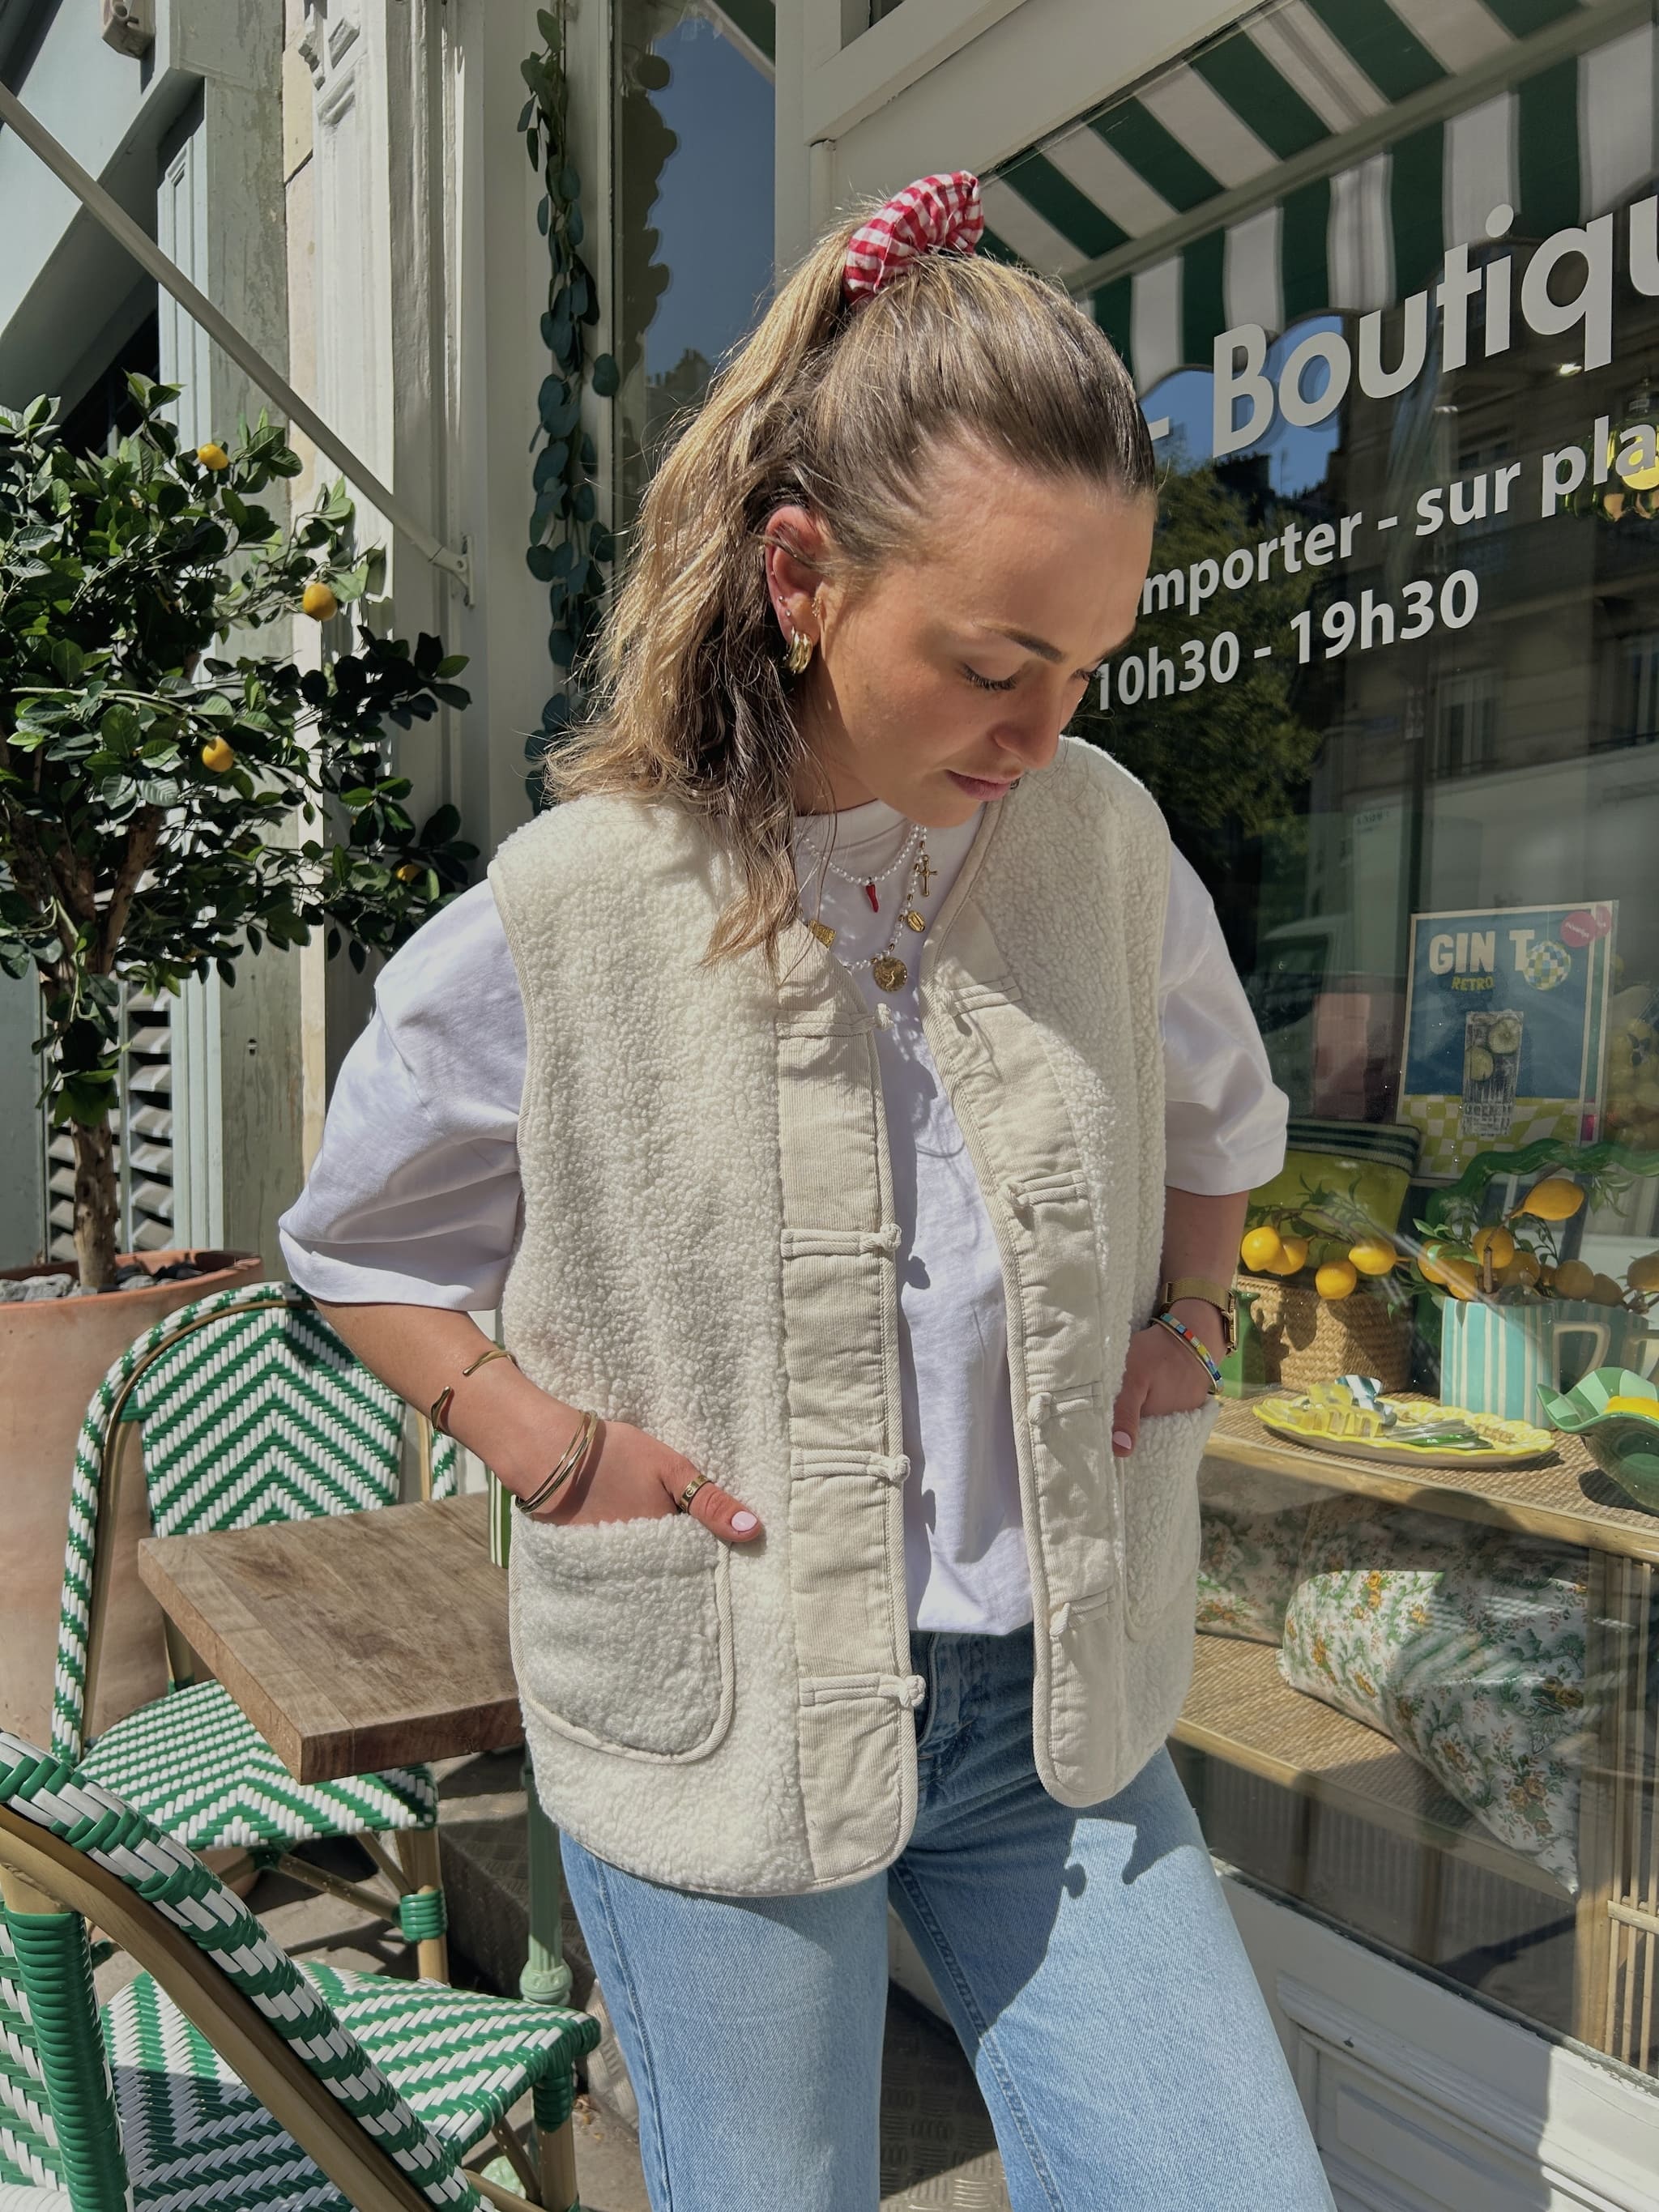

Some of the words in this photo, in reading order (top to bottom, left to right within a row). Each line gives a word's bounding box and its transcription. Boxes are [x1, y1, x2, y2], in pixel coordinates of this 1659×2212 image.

[1143, 513, 1363, 616] mporter
[1416, 462, 1520, 536] sur
[1542, 416, 1657, 518] pla
[1098, 631, 1239, 711] 10h30
[1290, 569, 1479, 665] 19h30
[1430, 931, 1495, 974] GIN
[1452, 976, 1494, 992] RETRO
